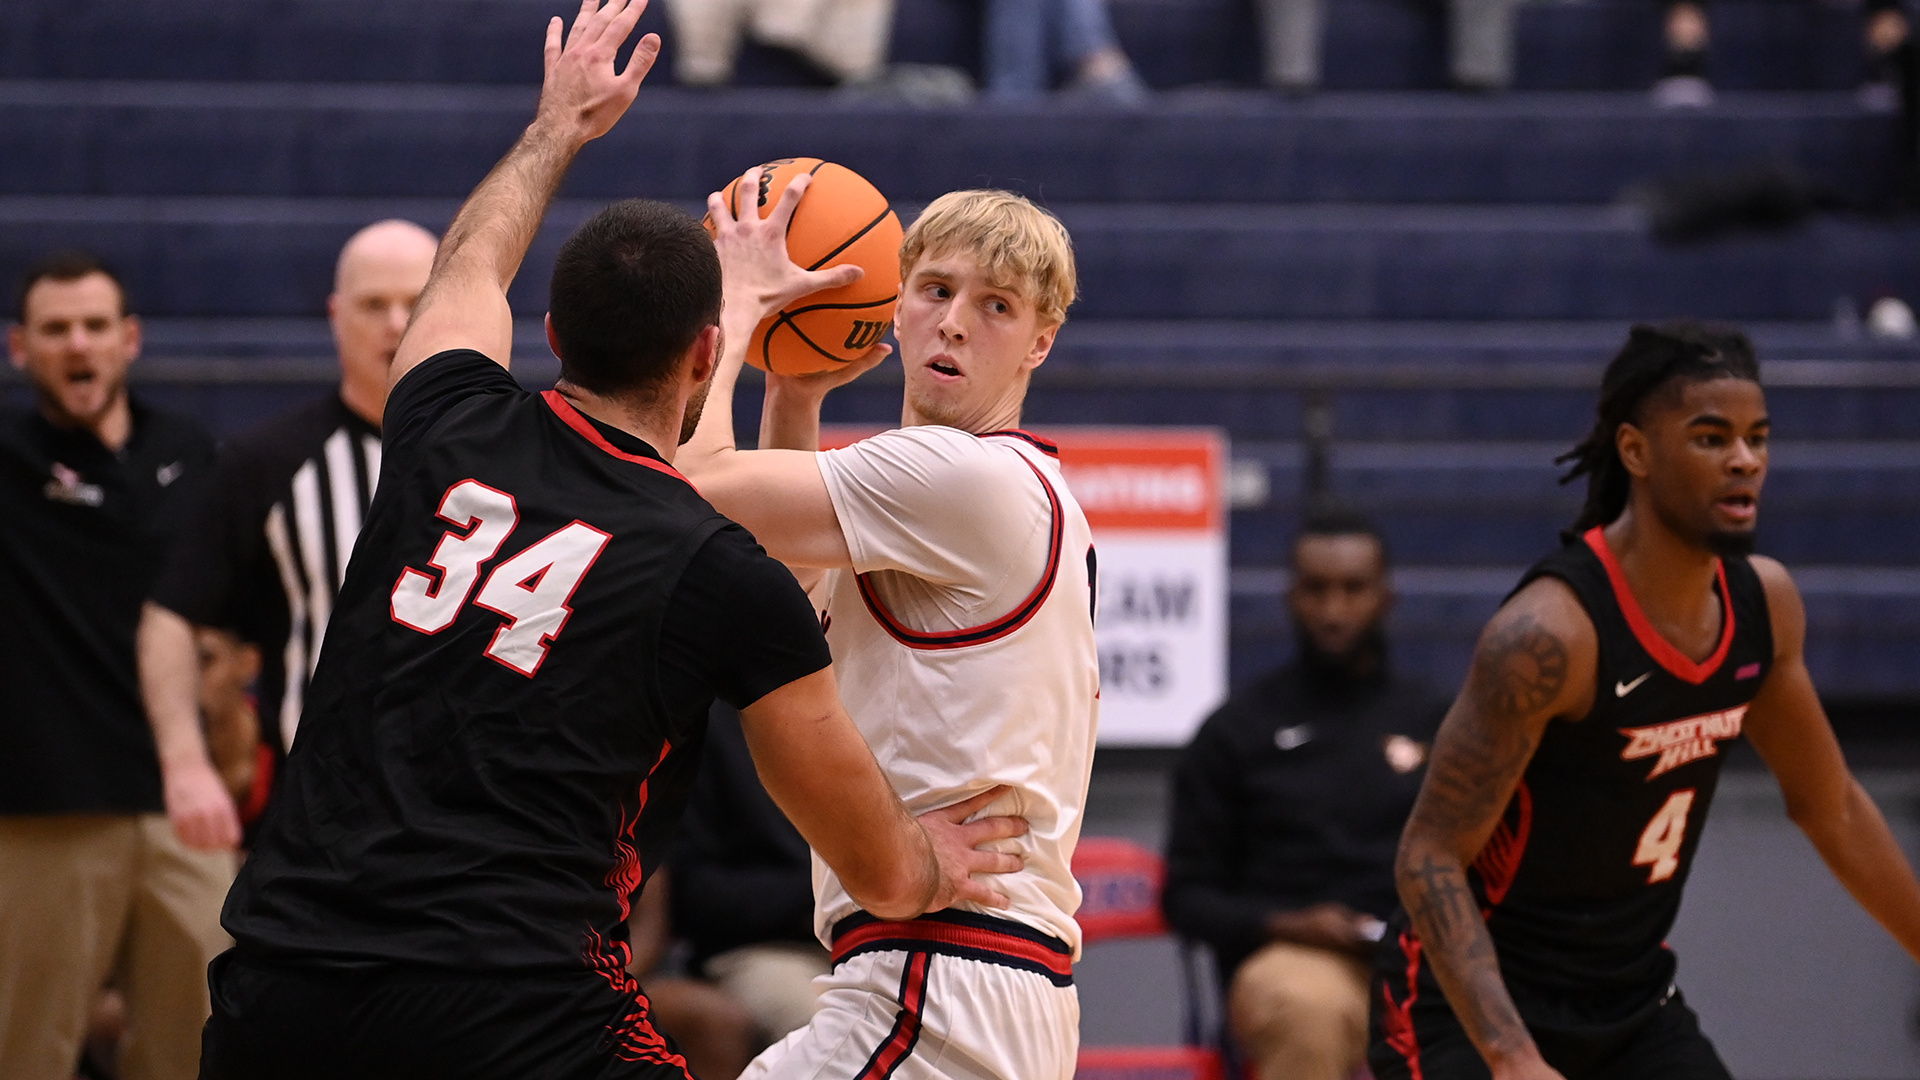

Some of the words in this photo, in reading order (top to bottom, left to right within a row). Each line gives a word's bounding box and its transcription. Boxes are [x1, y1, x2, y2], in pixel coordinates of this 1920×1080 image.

[390, 478, 613, 679] 34
[1617, 702, 1750, 761] CHESTNUT
[1645, 736, 1719, 782] HILL
[1631, 787, 1697, 884] 4
